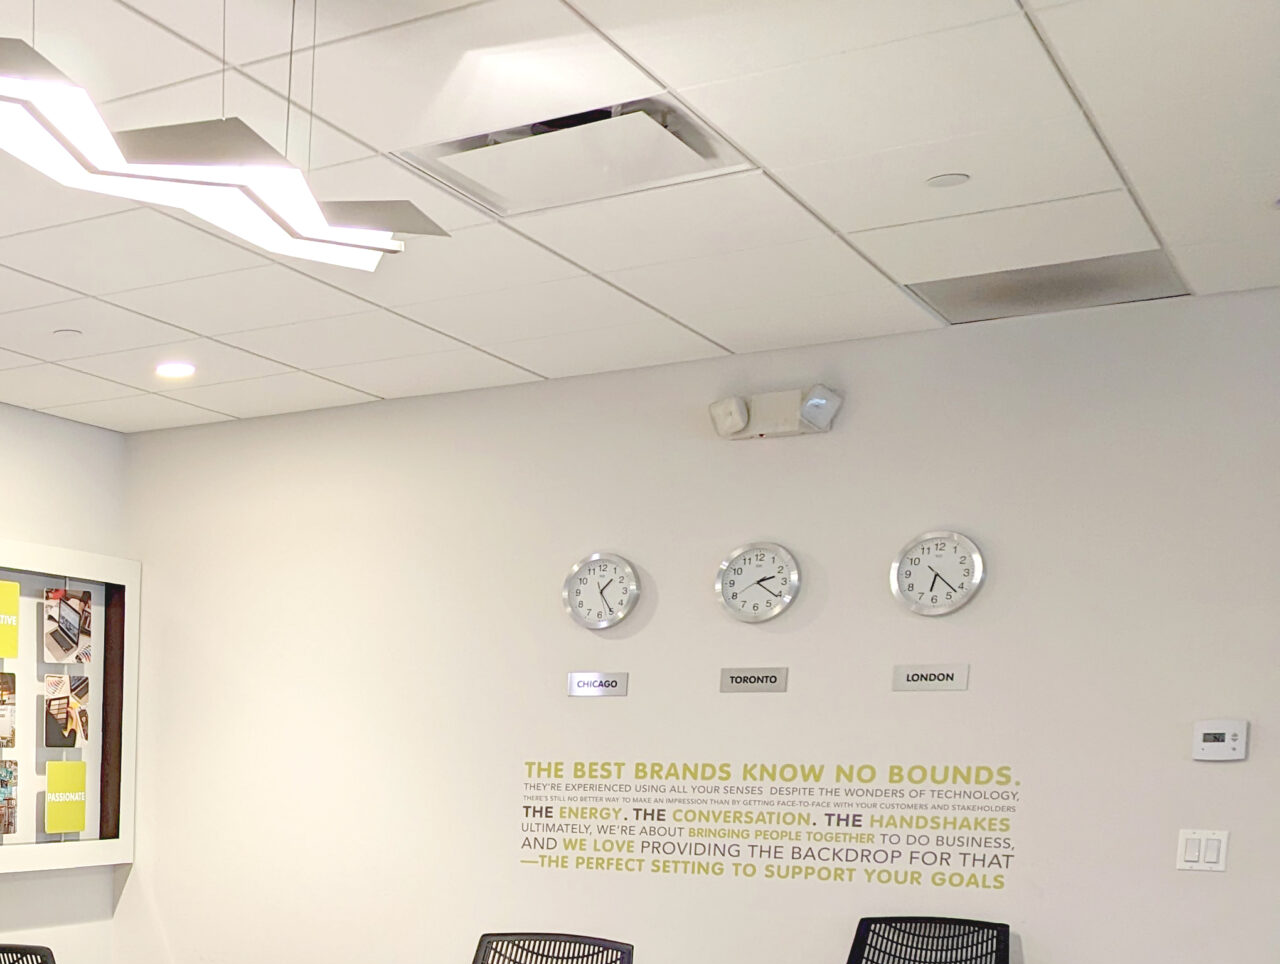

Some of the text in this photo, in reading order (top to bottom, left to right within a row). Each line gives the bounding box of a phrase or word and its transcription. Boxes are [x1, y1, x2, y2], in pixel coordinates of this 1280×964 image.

[576, 679, 618, 689] CHICAGO
[729, 675, 778, 685] TORONTO
[906, 672, 955, 683] LONDON
[524, 761, 1020, 786] THE BEST BRANDS KNOW NO BOUNDS.
[48, 792, 87, 802] PASSIONATE
[523, 782, 1020, 802] THEY'RE EXPERIENCED USING ALL YOUR SENSES DESPITE THE WONDERS OF TECHNOLOGY,
[776, 800, 832, 808] FACE-TO-FACE
[833, 801, 854, 809] WITH
[879, 803, 929, 811] CUSTOMERS
[951, 805, 1017, 813] STAKEHOLDERS
[522, 805, 554, 818] THE
[632, 808, 666, 821] THE
[672, 809, 817, 826] CONVERSATION.
[824, 813, 863, 828] THE
[870, 814, 1011, 832] HANDSHAKES
[521, 822, 1015, 851] ULTIMATELY, WE'RE ABOUT BRINGING PEOPLE TOGETHER TO DO BUSINESS,
[521, 837, 1015, 869] AND WE LOVE PROVIDING THE BACKDROP FOR THAT
[575, 856, 646, 873] PERFECT
[650, 859, 725, 876] SETTING
[731, 862, 757, 877] TO
[764, 864, 857, 882] SUPPORT
[863, 868, 922, 886] YOUR
[930, 872, 1006, 890] GOALS
